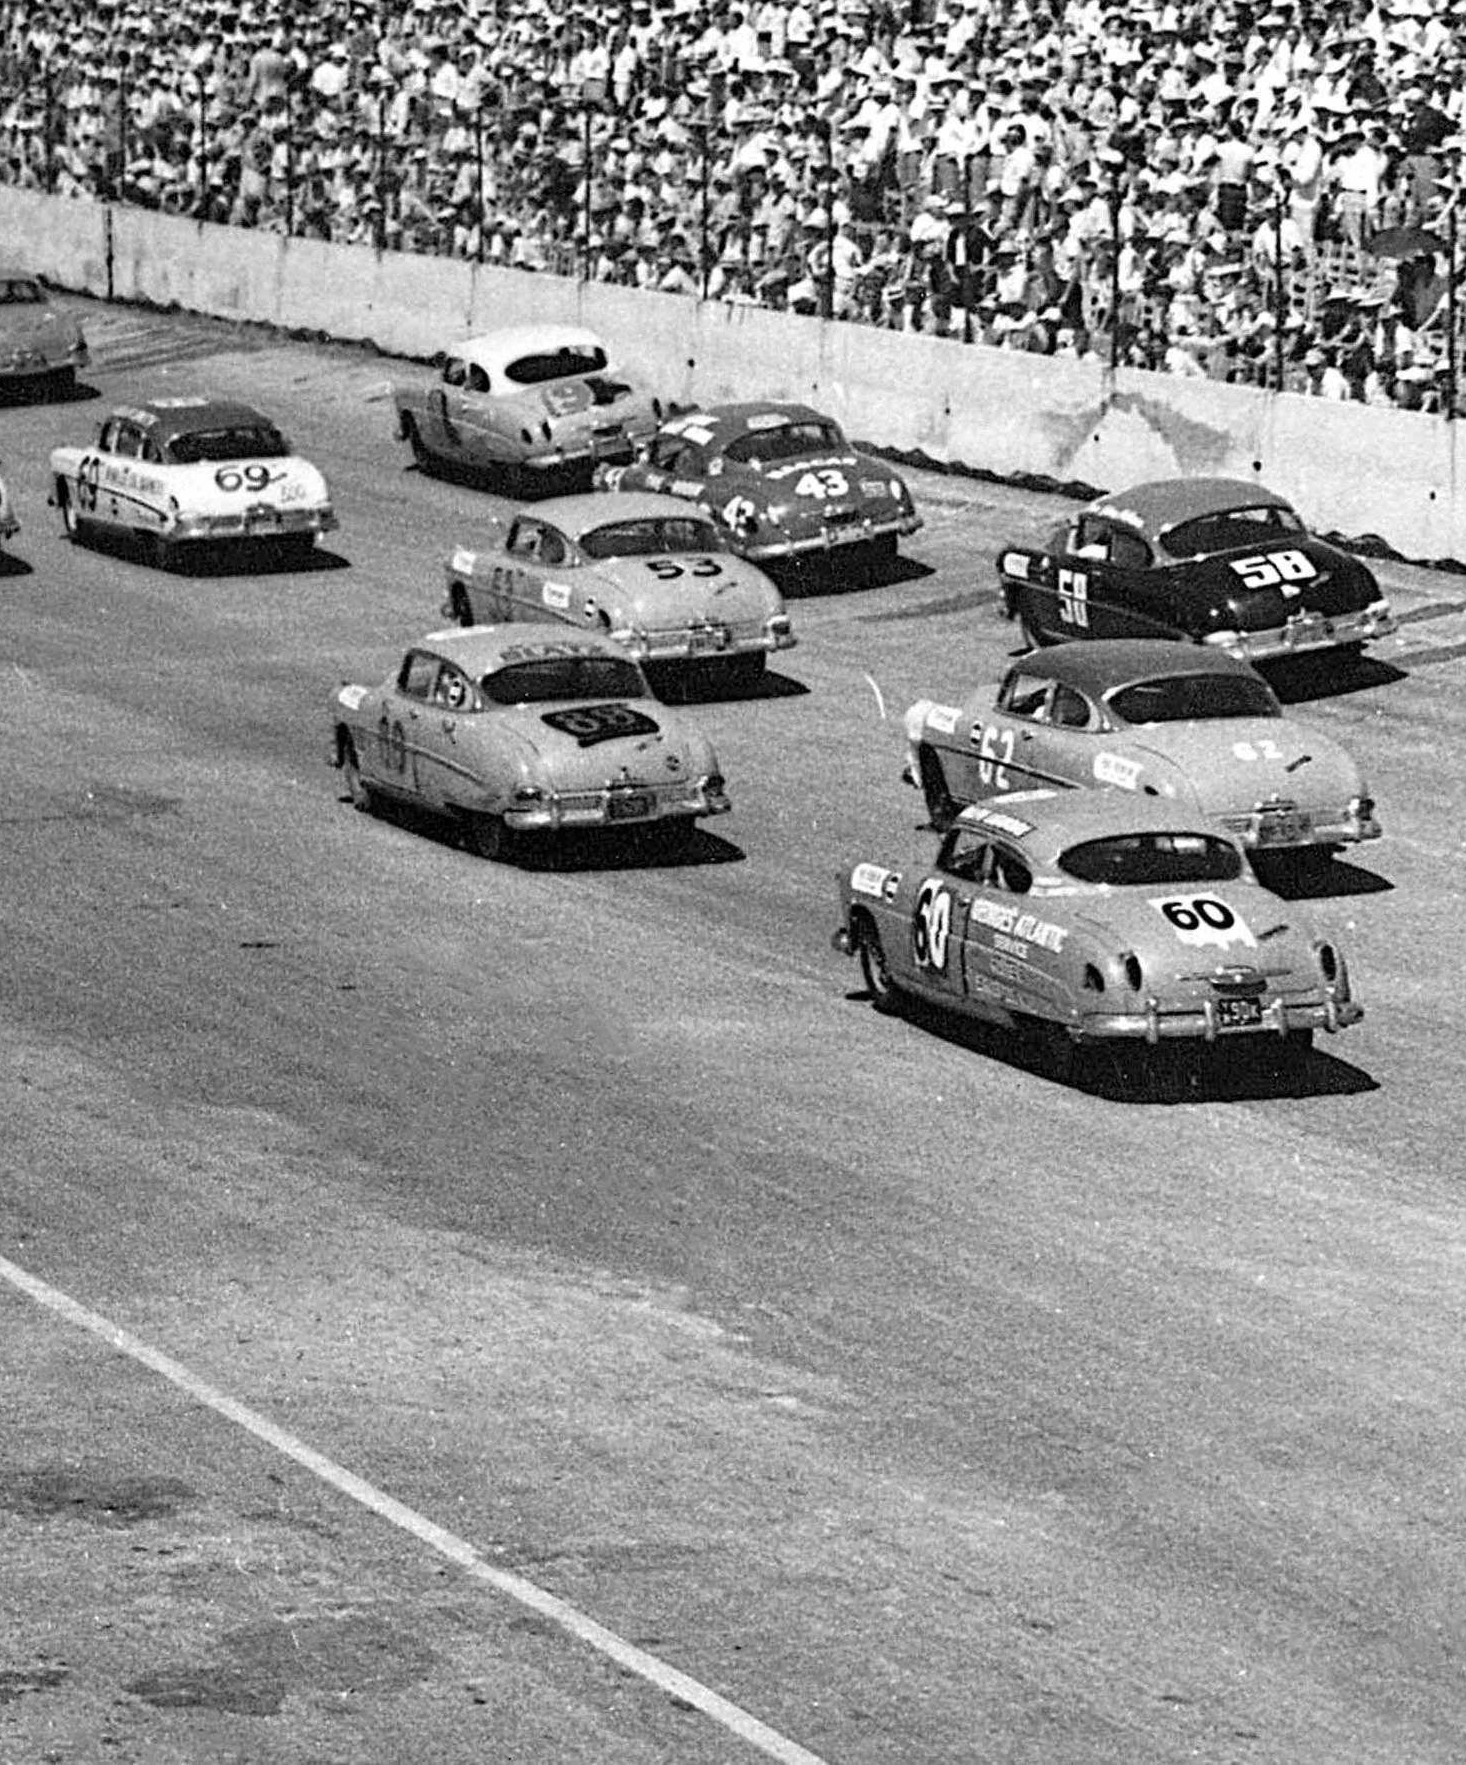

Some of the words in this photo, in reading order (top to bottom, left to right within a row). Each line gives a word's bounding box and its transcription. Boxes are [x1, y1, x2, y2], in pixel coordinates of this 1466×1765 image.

[214, 464, 271, 493] 69
[794, 469, 850, 499] 43
[645, 557, 723, 580] 53
[1228, 549, 1318, 589] 58
[979, 726, 1014, 790] 62
[914, 878, 951, 970] 60
[1162, 899, 1235, 931] 60
